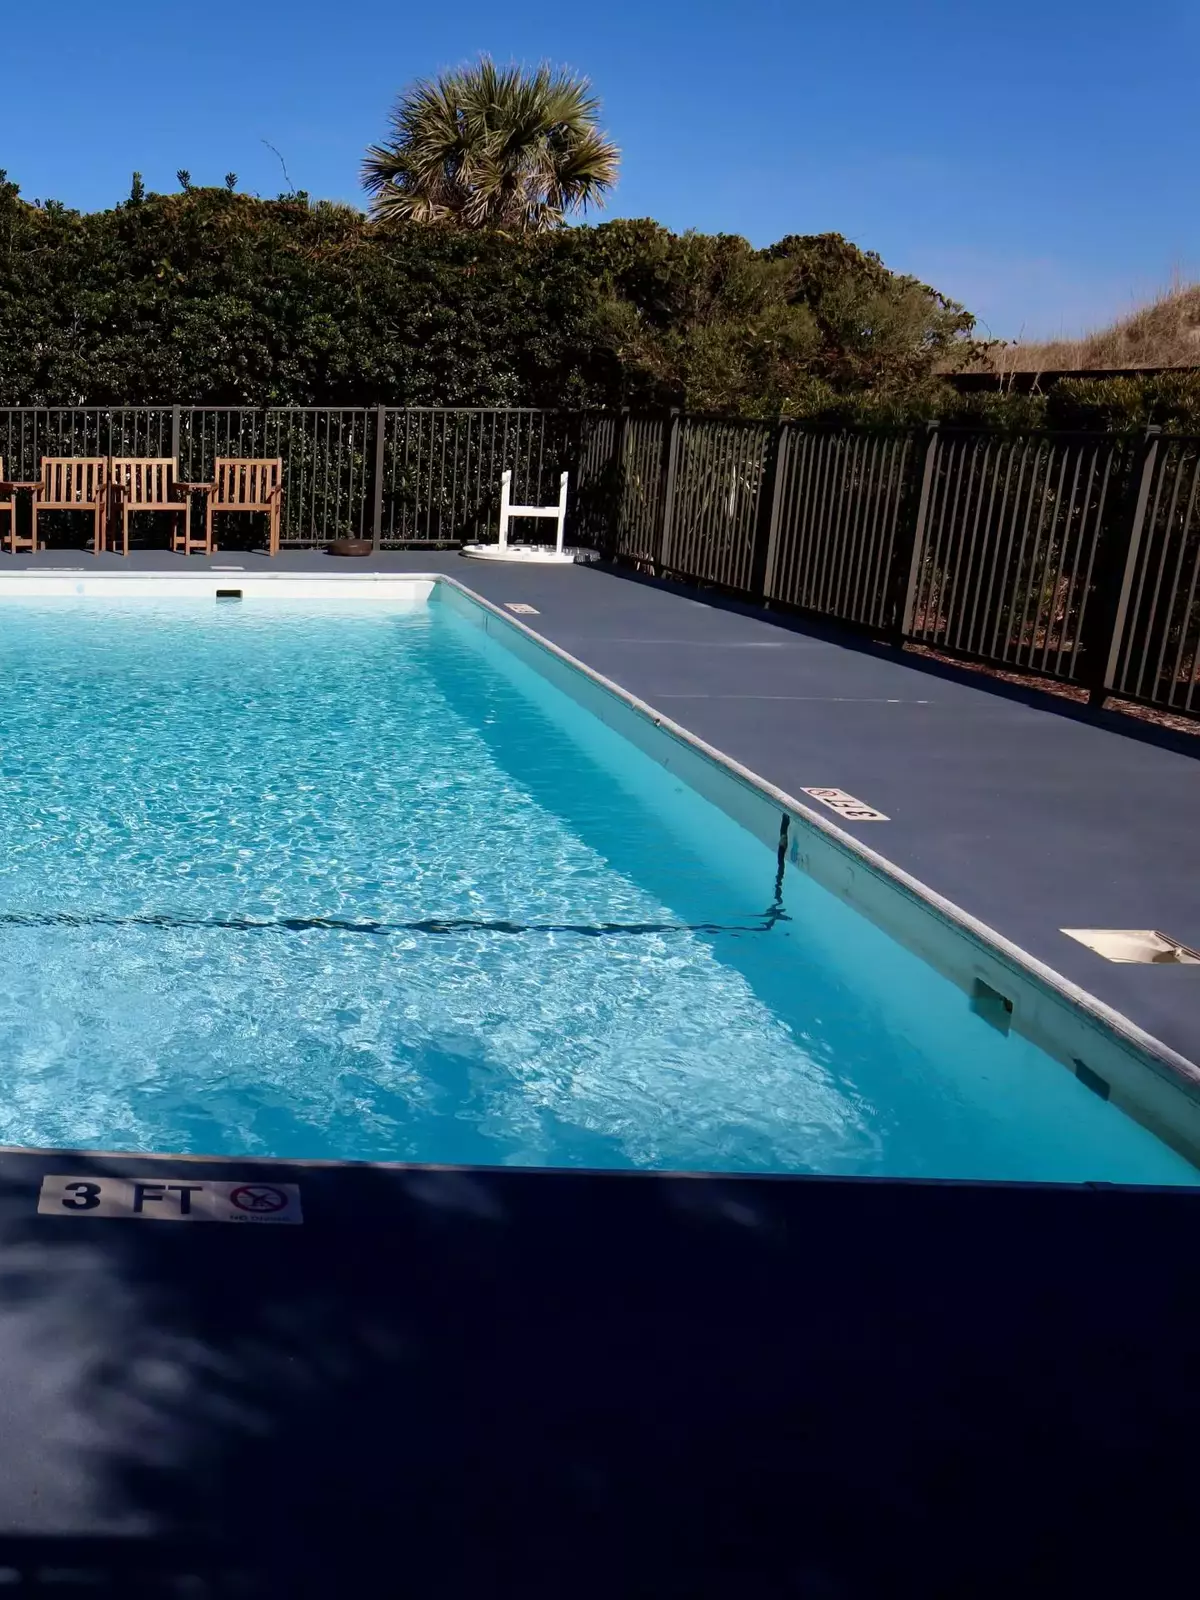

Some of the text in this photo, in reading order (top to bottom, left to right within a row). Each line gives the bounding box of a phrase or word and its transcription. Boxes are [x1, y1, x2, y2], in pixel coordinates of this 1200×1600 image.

[823, 798, 864, 808] FT
[62, 1182, 203, 1215] 3 FT
